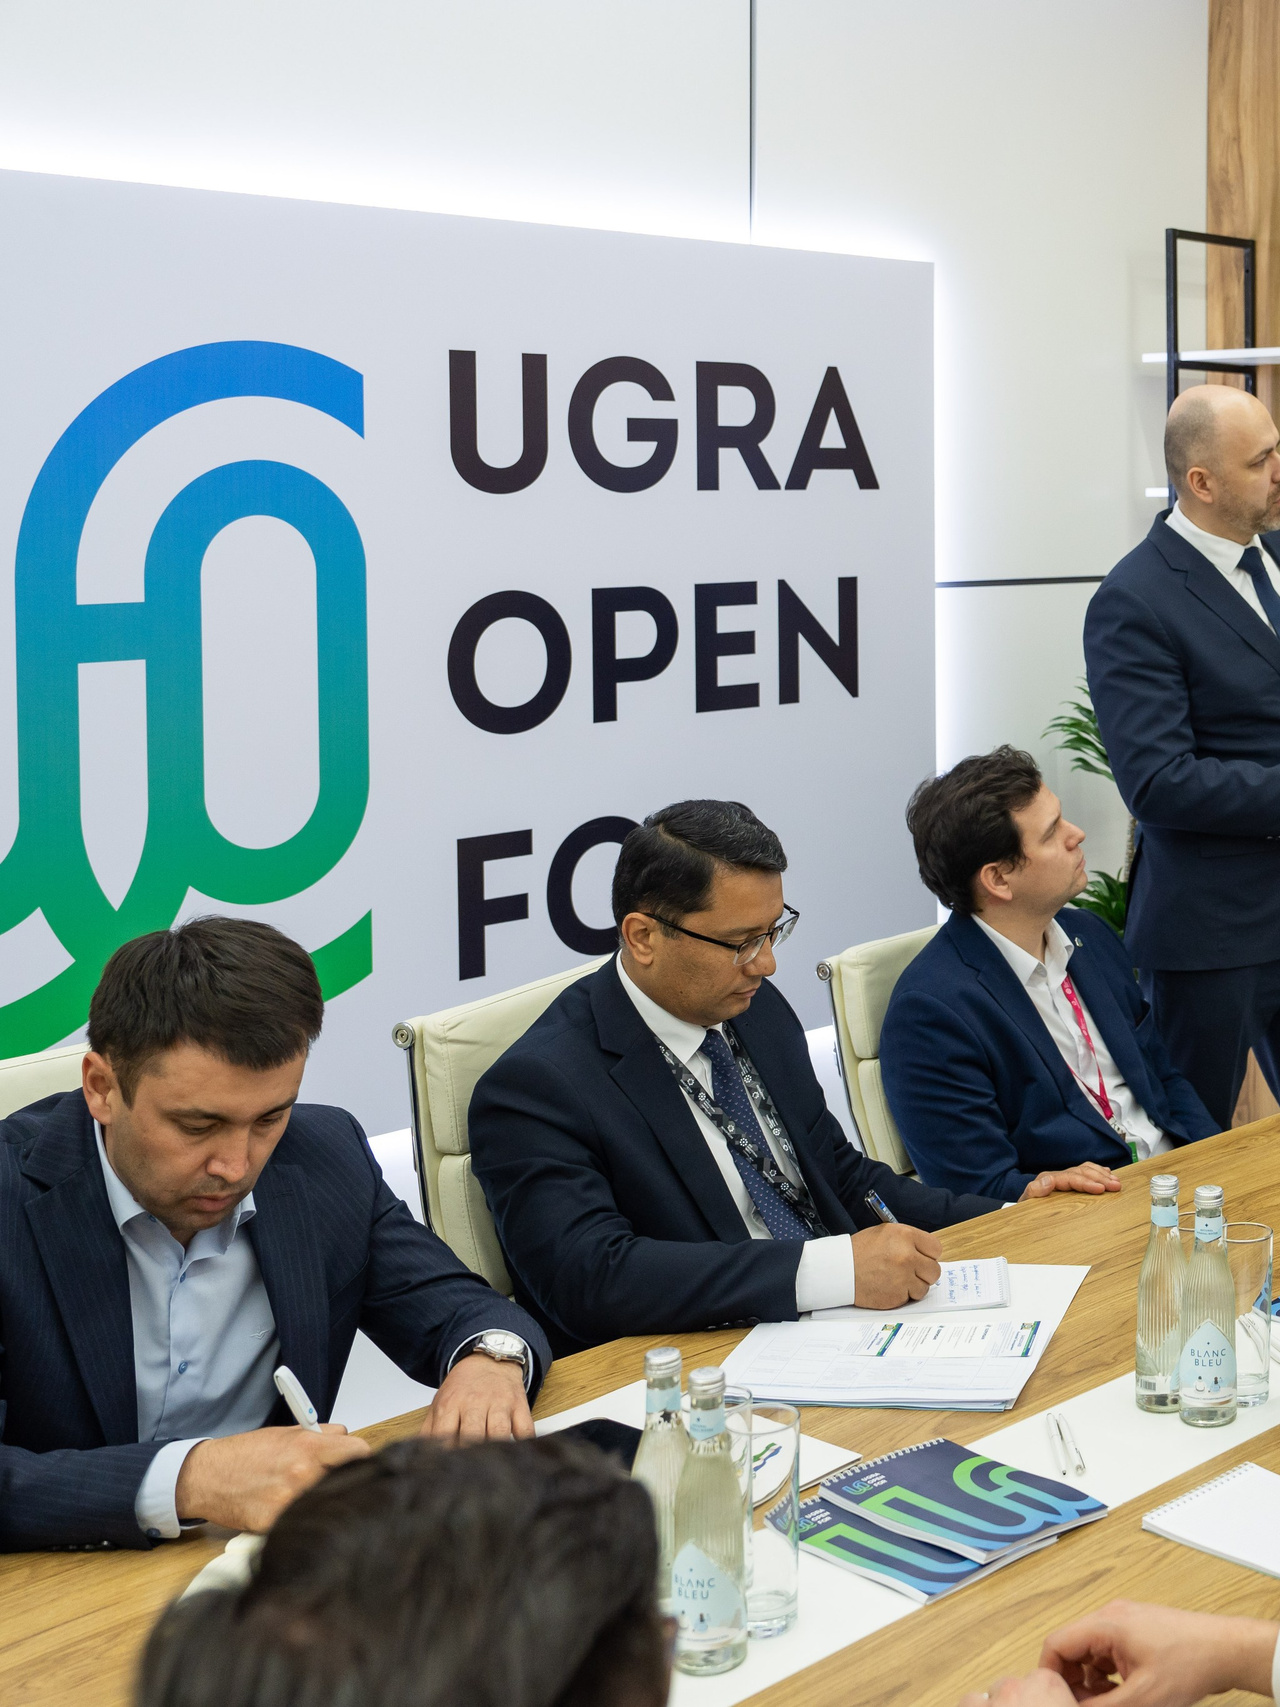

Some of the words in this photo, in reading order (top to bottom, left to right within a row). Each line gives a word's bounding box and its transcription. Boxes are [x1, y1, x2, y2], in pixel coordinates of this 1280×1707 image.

[449, 350, 880, 494] UGRA
[447, 576, 859, 735] OPEN
[456, 800, 752, 981] FO
[1191, 1349, 1226, 1357] BLANC
[675, 1574, 715, 1587] BLANC
[678, 1587, 709, 1599] BLEU
